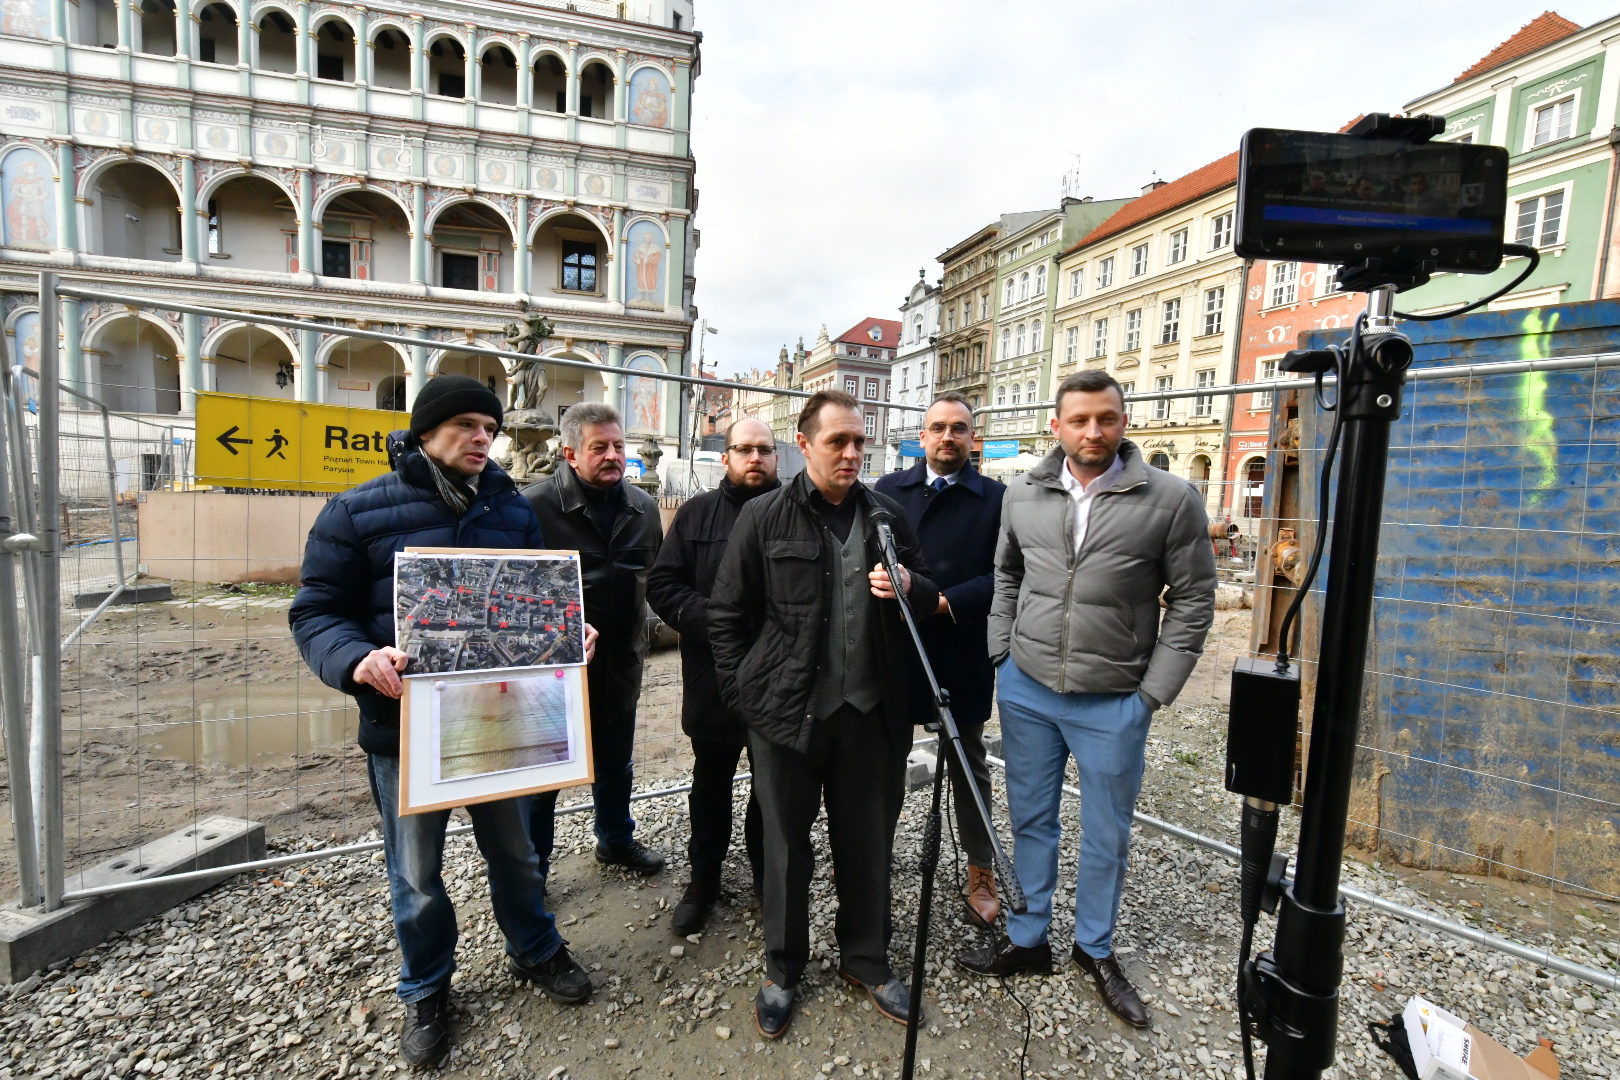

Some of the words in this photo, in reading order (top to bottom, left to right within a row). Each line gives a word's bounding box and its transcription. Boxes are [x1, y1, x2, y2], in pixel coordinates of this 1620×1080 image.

[325, 425, 389, 453] Rat
[355, 457, 376, 465] Town
[1461, 1037, 1470, 1066] SHURE
